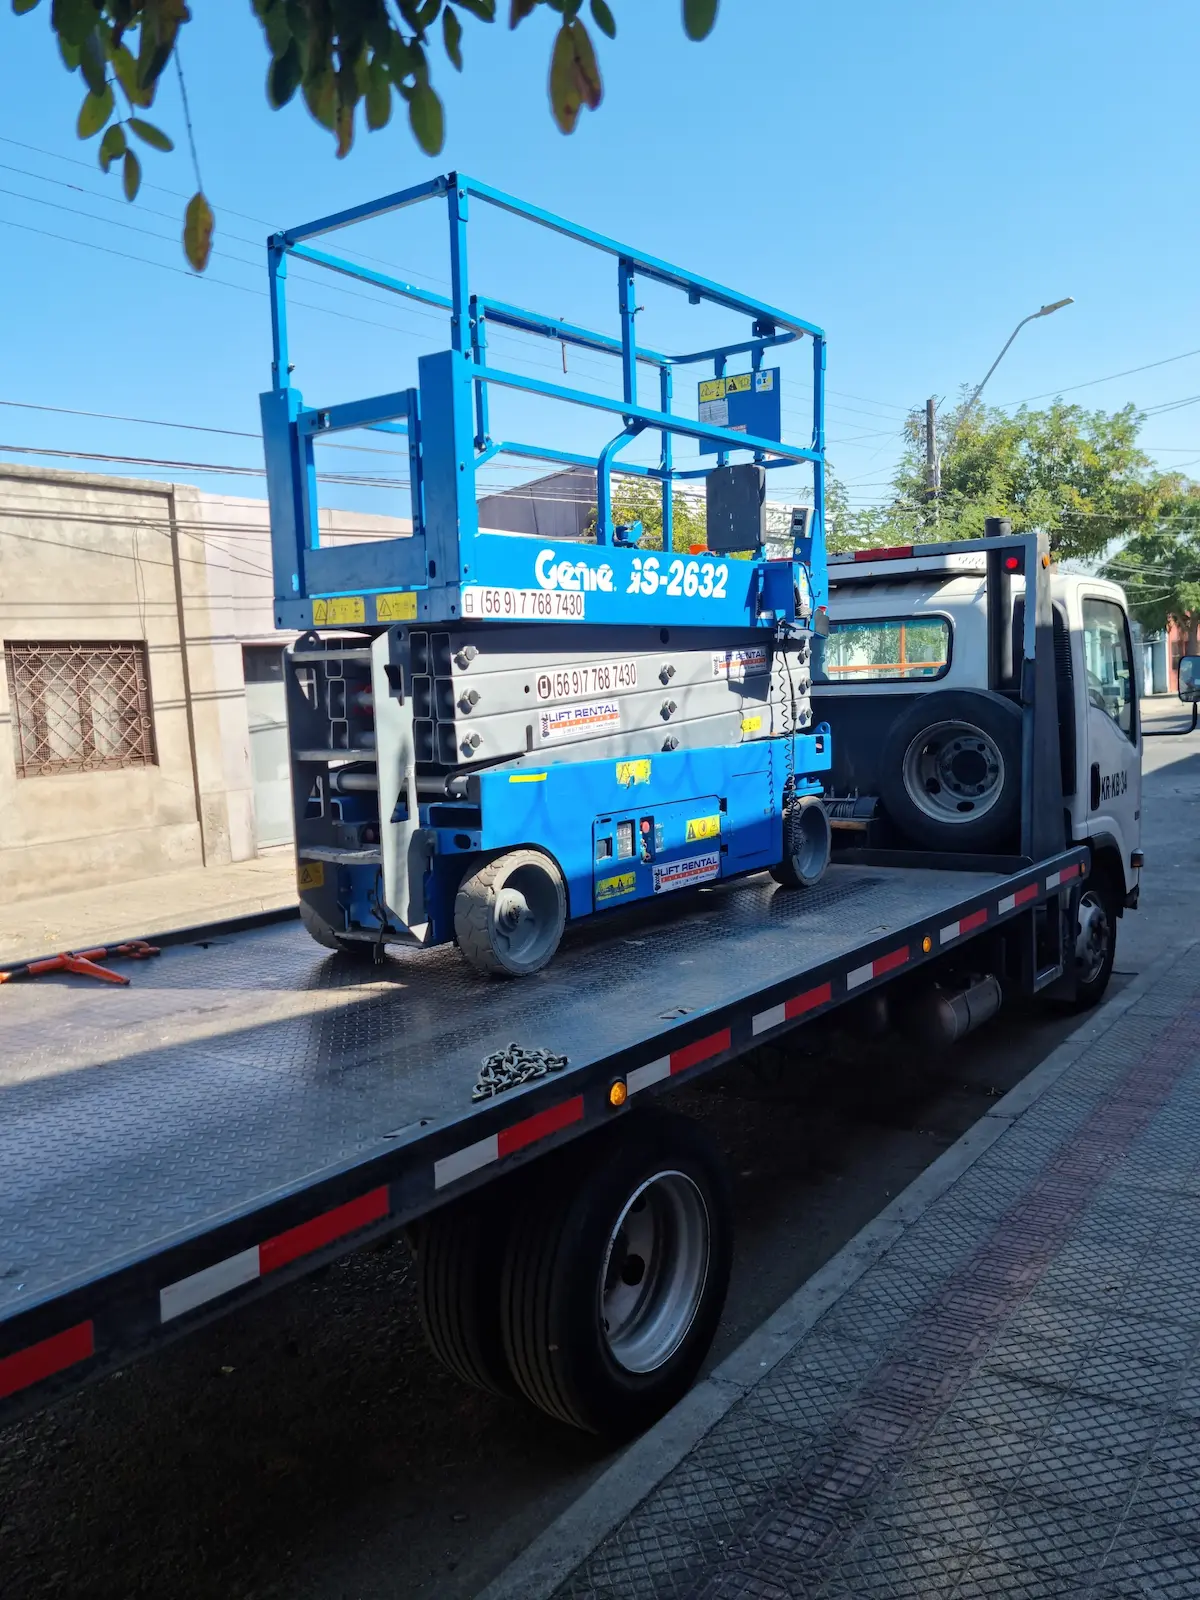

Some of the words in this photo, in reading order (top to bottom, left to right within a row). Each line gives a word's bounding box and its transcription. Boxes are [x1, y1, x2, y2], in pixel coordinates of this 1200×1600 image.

[535, 549, 613, 592] Genie
[481, 590, 500, 614] (56
[504, 591, 516, 614] 9)
[520, 592, 526, 614] 7
[531, 592, 552, 615] 768
[555, 594, 582, 615] 7430
[553, 672, 570, 698] (56
[591, 667, 610, 691] 768
[613, 663, 636, 688] 7430
[548, 710, 571, 723] LIFT
[574, 704, 618, 719] RENTAL
[660, 864, 680, 876] LIFT
[681, 856, 717, 872] RENTAL
